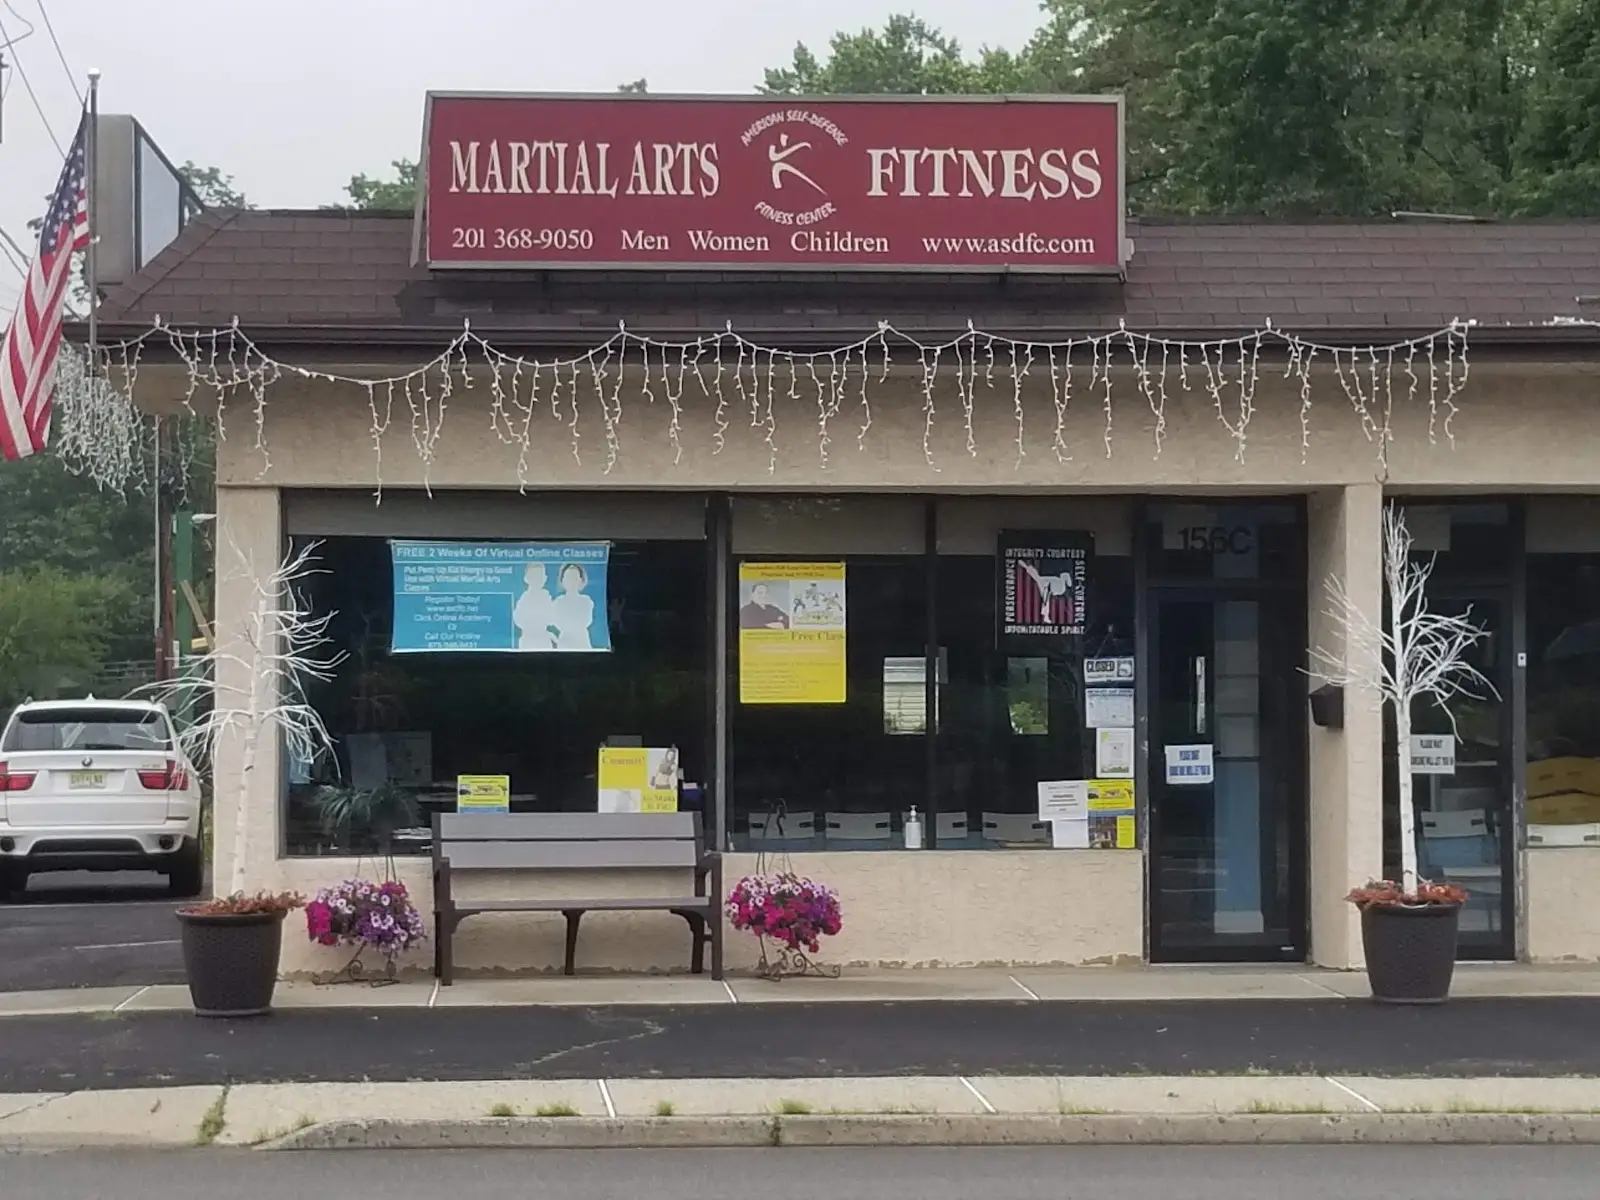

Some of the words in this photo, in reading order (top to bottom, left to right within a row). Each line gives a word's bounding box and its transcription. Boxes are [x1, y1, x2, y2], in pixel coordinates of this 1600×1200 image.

[740, 111, 785, 147] AMERICAN
[786, 109, 849, 147] SELF-DEFENSE
[449, 140, 619, 199] MARTIAL
[625, 140, 720, 198] ARTS
[866, 147, 1102, 201] FITNESS
[754, 201, 795, 226] FITNESS
[796, 202, 837, 226] CENTER
[452, 228, 486, 249] 201
[493, 228, 594, 251] 368-9050
[621, 229, 670, 251] Men
[687, 230, 770, 252] Women
[790, 231, 890, 253] Children
[921, 233, 1096, 255] www.asdfc.com
[396, 547, 425, 557] FREE
[429, 548, 435, 557] 2
[438, 547, 472, 557] Weeks
[475, 548, 488, 557] Of
[490, 548, 523, 557] Virtual
[528, 548, 560, 558] Online
[562, 548, 604, 558] Classes
[1178, 526, 1253, 555] 156C
